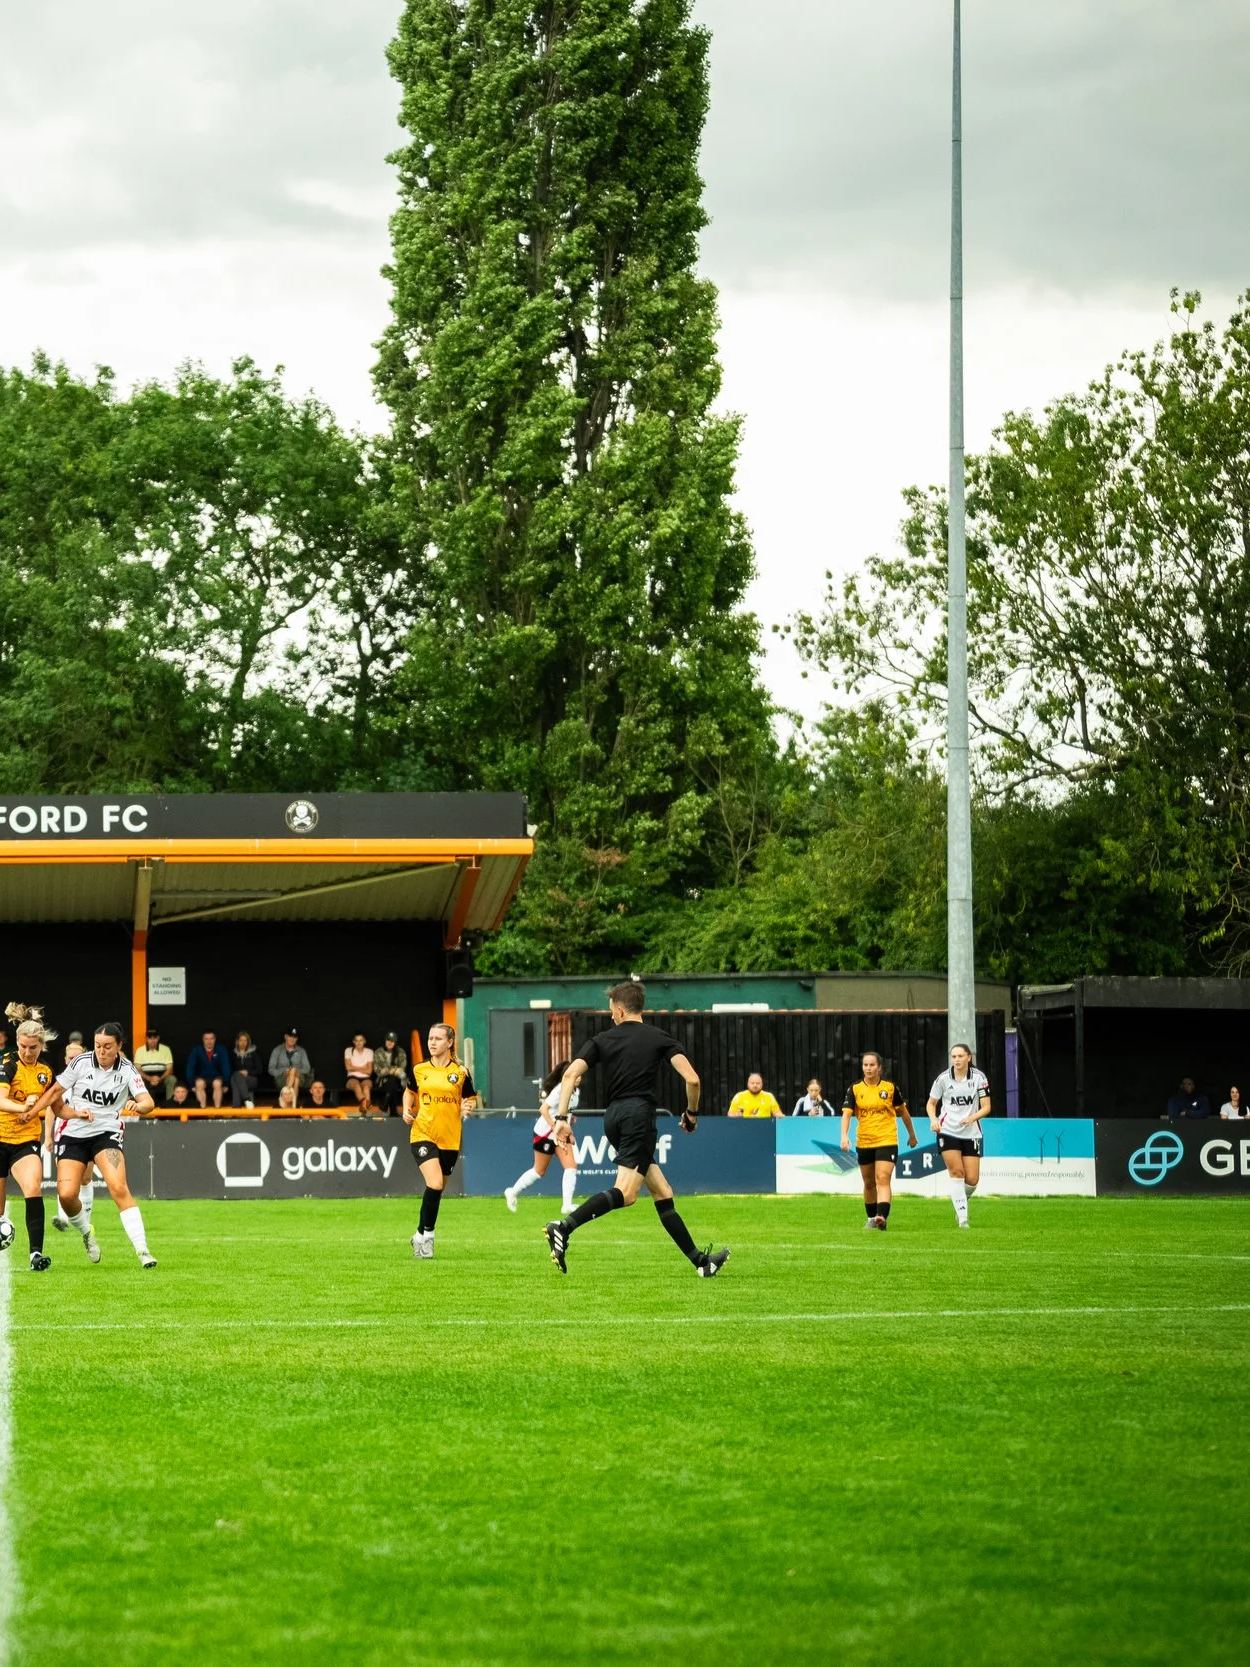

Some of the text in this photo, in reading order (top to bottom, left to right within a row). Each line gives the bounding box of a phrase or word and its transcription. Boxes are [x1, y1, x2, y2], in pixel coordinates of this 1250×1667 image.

[102, 804, 148, 833] FC
[81, 1087, 120, 1106] AEW
[282, 1139, 398, 1181] galaxy
[572, 1133, 672, 1165] Wf
